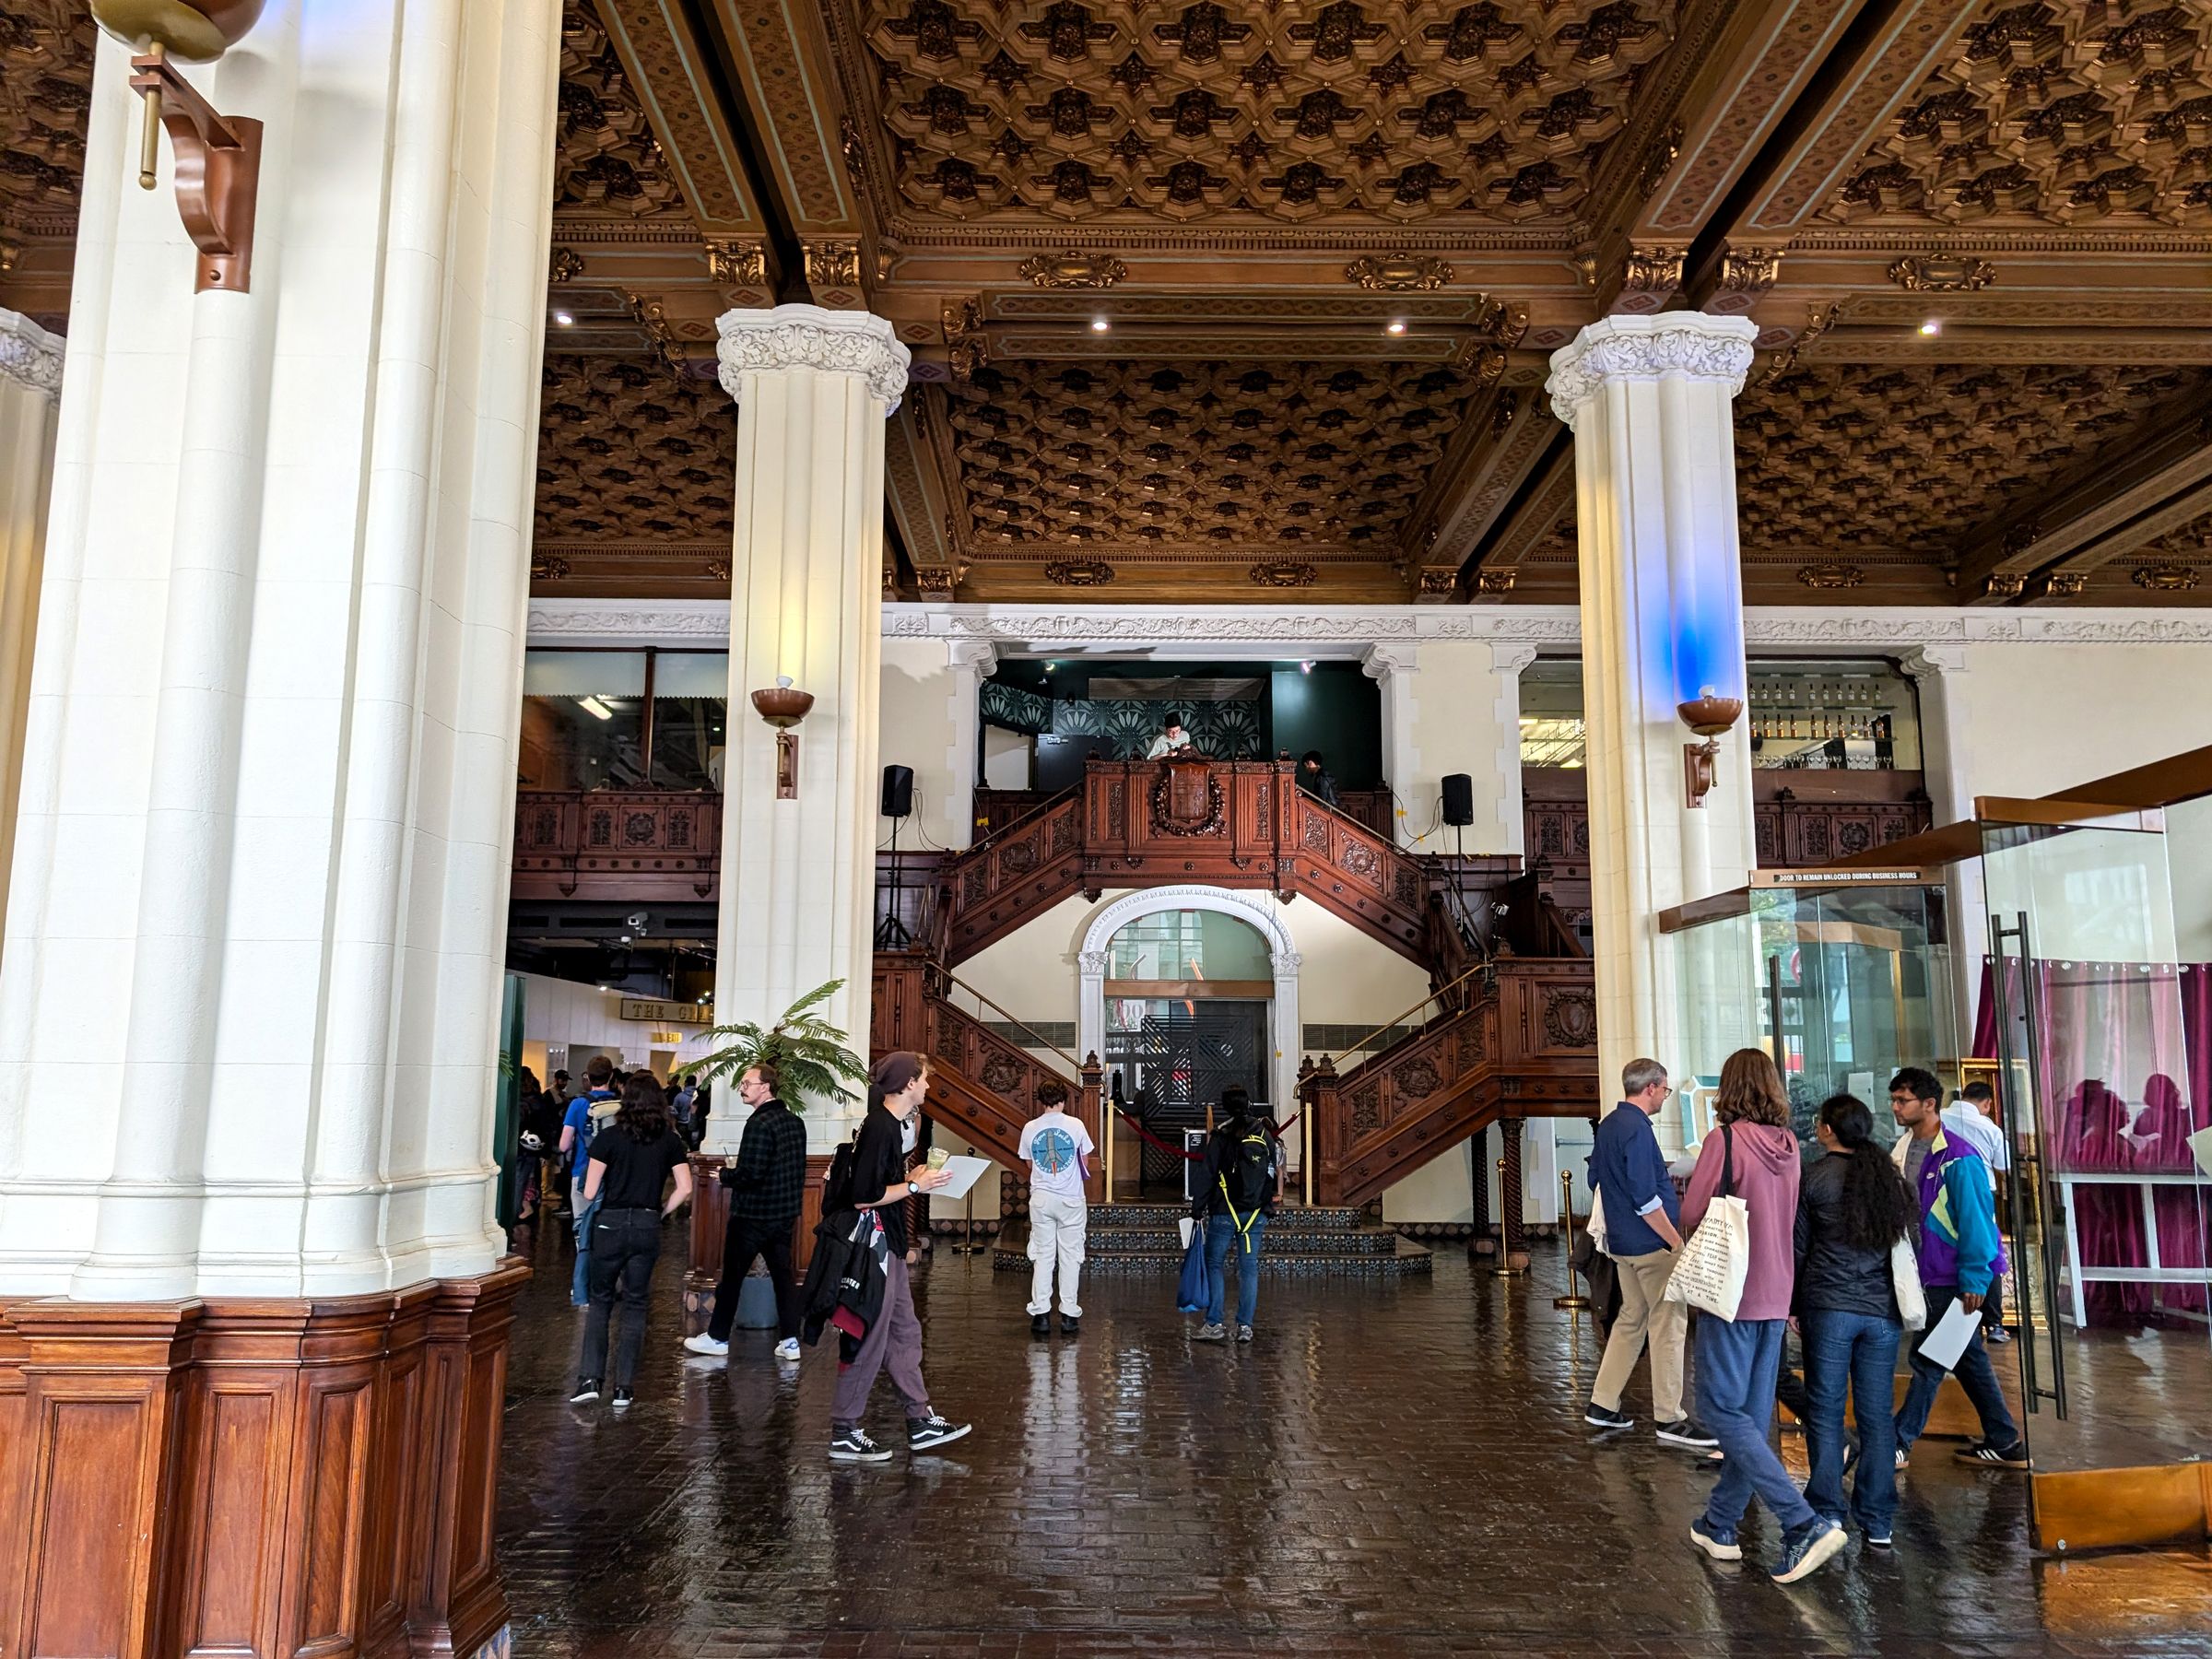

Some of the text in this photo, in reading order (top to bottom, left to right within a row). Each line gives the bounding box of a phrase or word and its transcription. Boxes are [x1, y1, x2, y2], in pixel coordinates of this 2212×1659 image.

[632, 1003, 664, 1018] THE
[667, 1033, 679, 1042] EXIT
[1057, 1155, 1075, 1171] FACTORY
